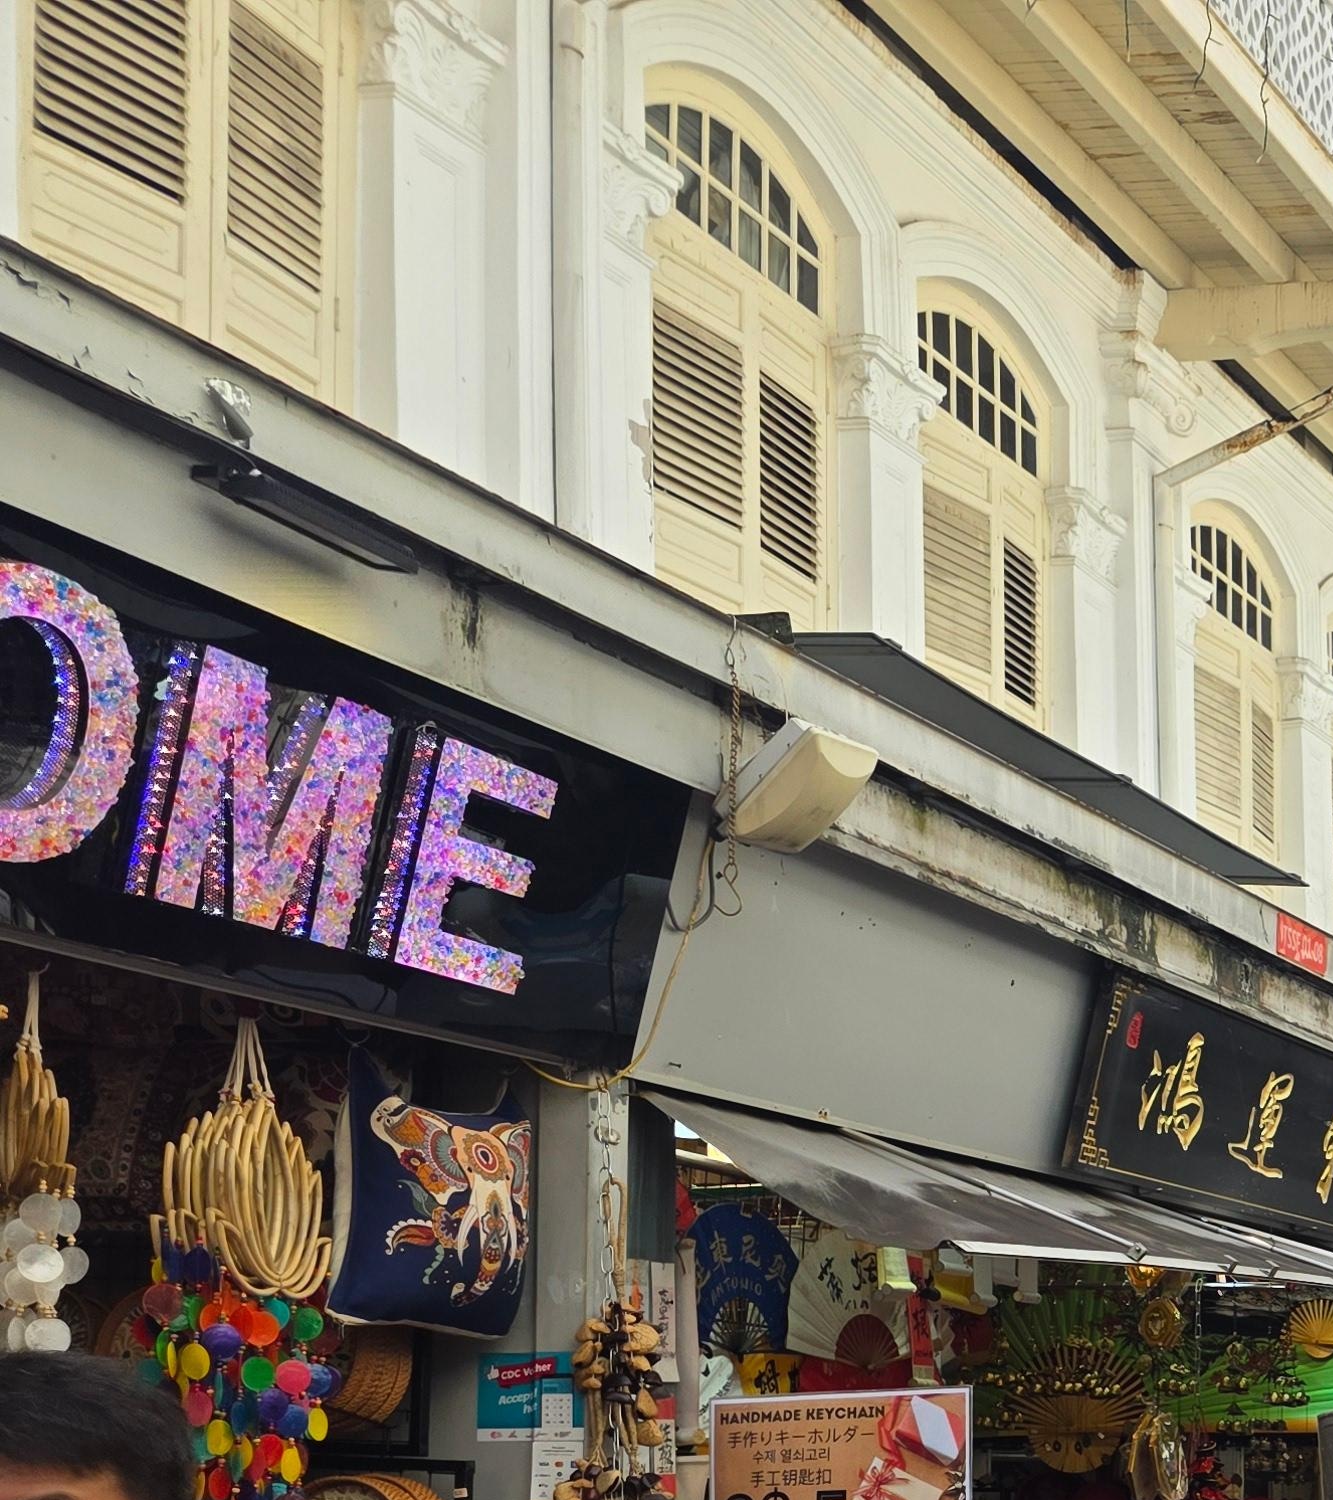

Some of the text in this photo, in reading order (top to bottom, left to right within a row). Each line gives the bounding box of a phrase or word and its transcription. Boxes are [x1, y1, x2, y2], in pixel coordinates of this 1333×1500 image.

[501, 1369, 521, 1380] CDC
[720, 1405, 885, 1425] HANDMADE KEYCHAIN
[727, 1426, 875, 1448] 手作りキーホルダー
[752, 1447, 831, 1464] 수제 열쇠고리
[751, 1469, 832, 1488] 手工钥匙扣
